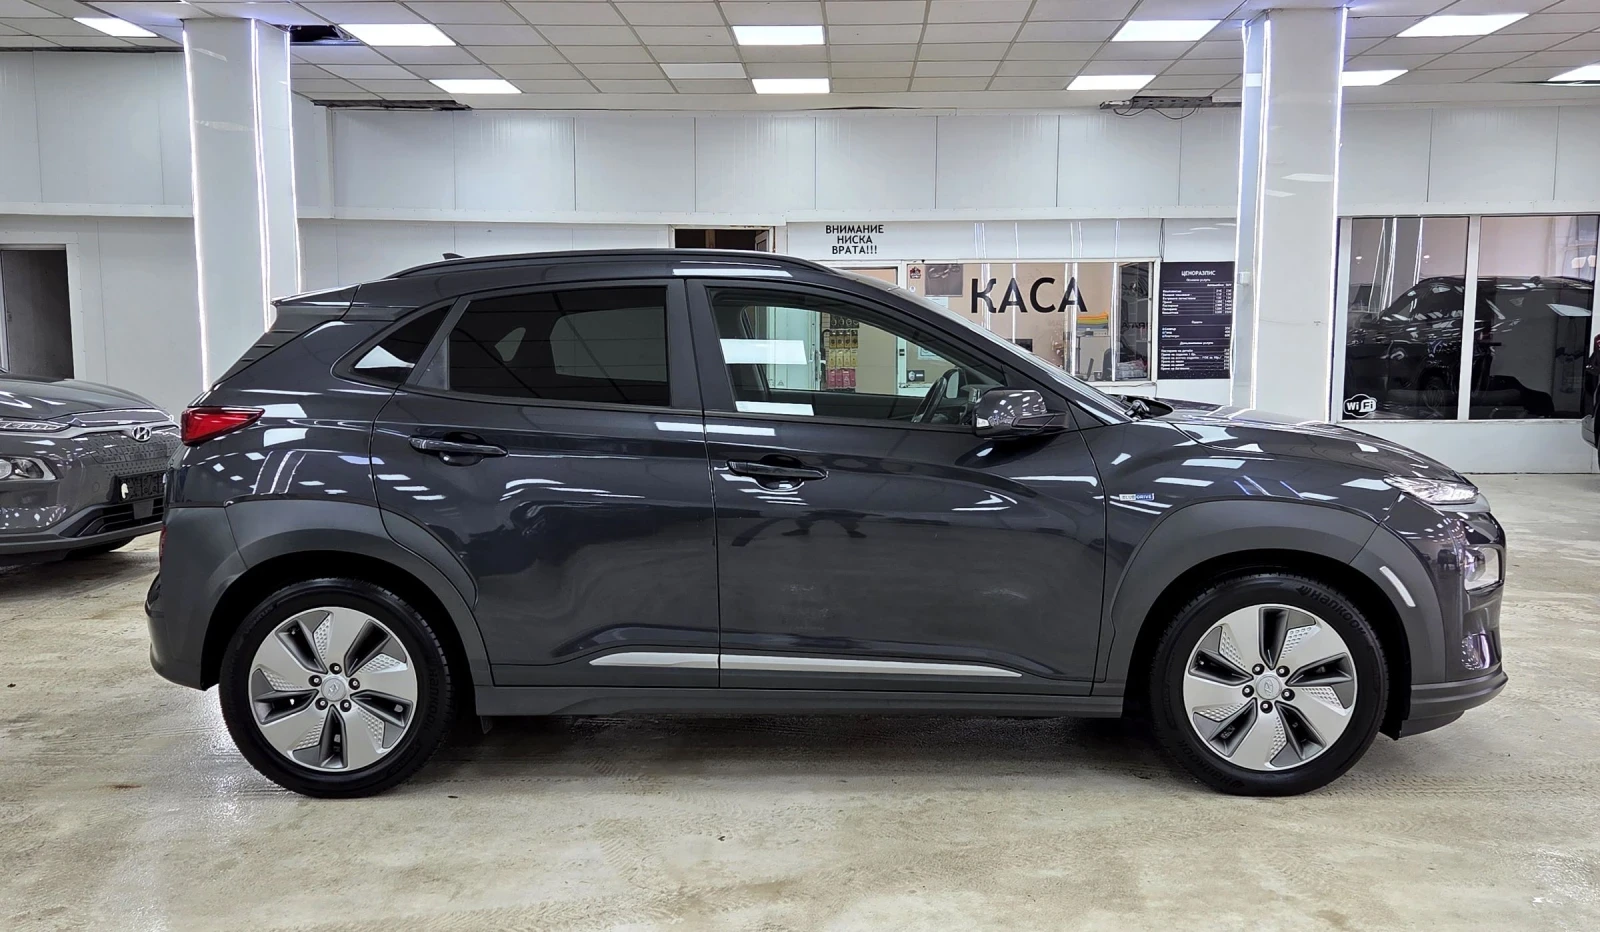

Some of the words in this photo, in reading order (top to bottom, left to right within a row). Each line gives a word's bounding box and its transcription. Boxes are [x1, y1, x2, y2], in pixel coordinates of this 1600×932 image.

[825, 224, 885, 234] ВНИМАНИЕ
[837, 235, 873, 244] НИСКА
[832, 245, 877, 254] ВРАТА!!!
[971, 276, 1088, 314] КАСА
